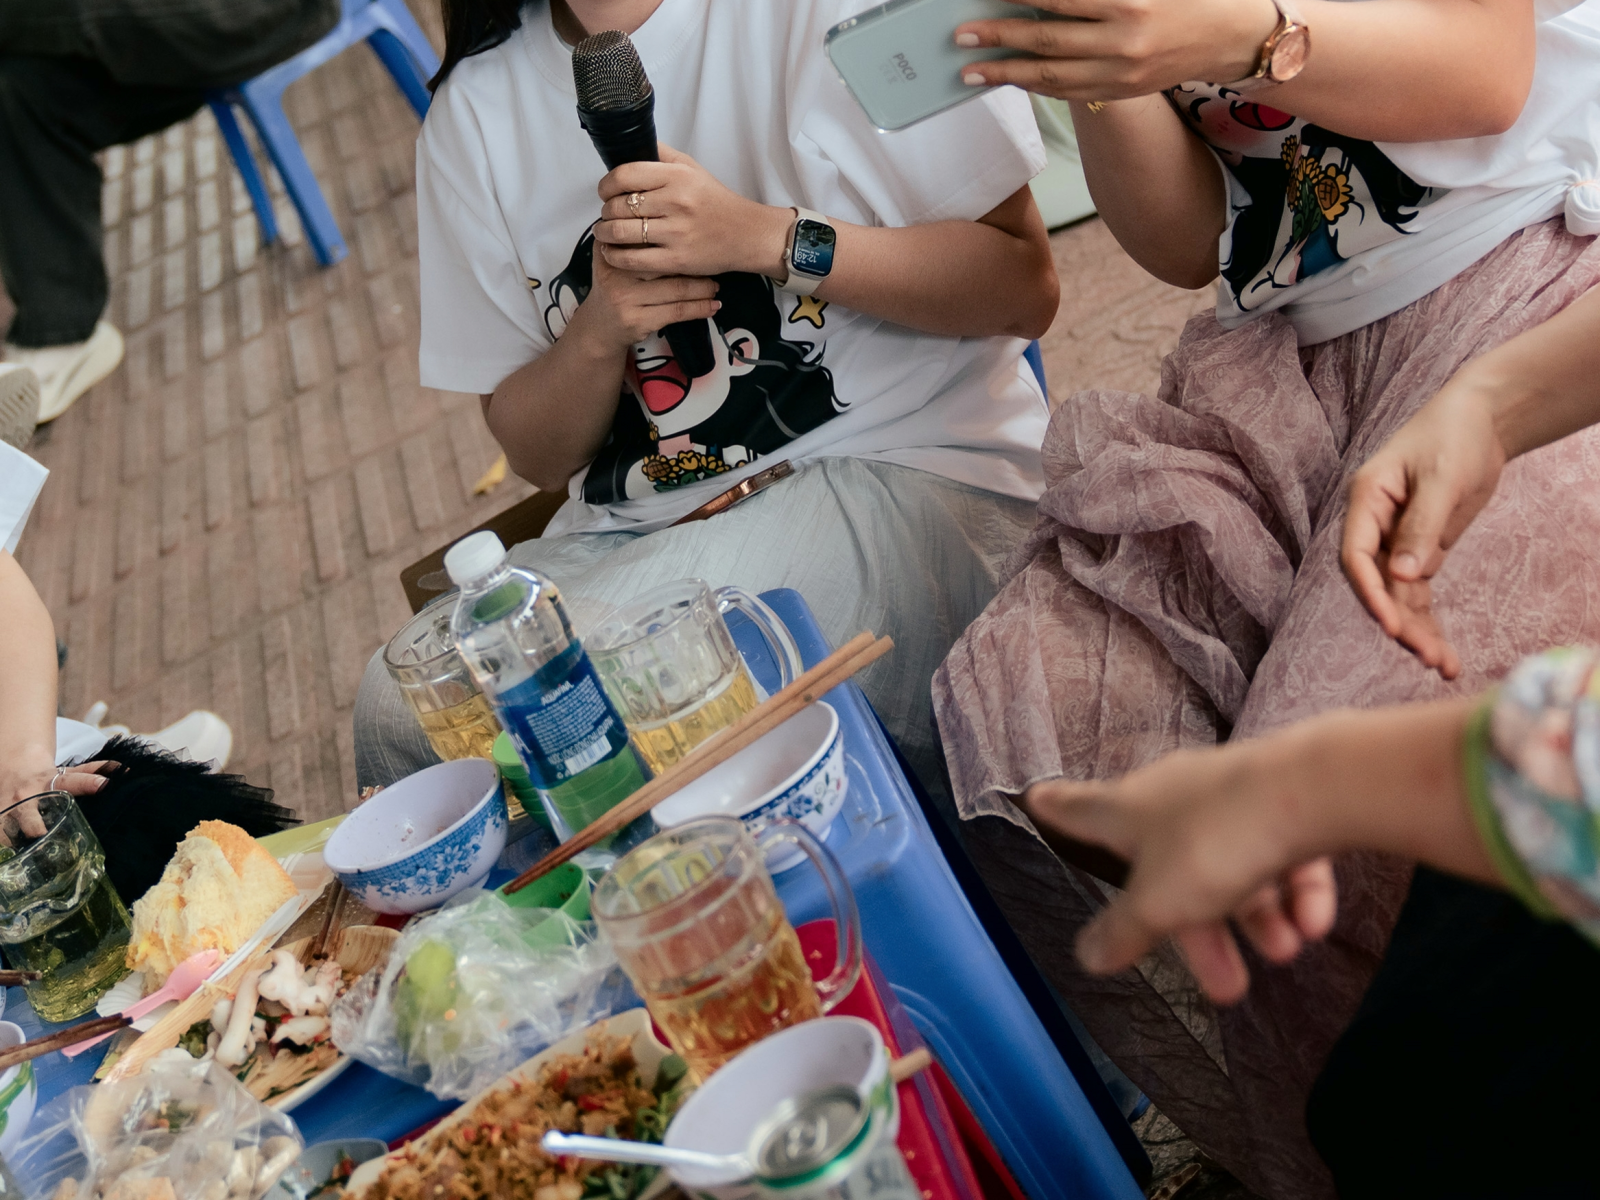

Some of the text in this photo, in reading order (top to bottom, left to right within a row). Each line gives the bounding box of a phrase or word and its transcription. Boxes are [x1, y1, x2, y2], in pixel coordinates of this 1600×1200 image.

[892, 52, 917, 80] POCO
[797, 251, 817, 263] 12:49
[541, 681, 574, 706] AQUAFINA
